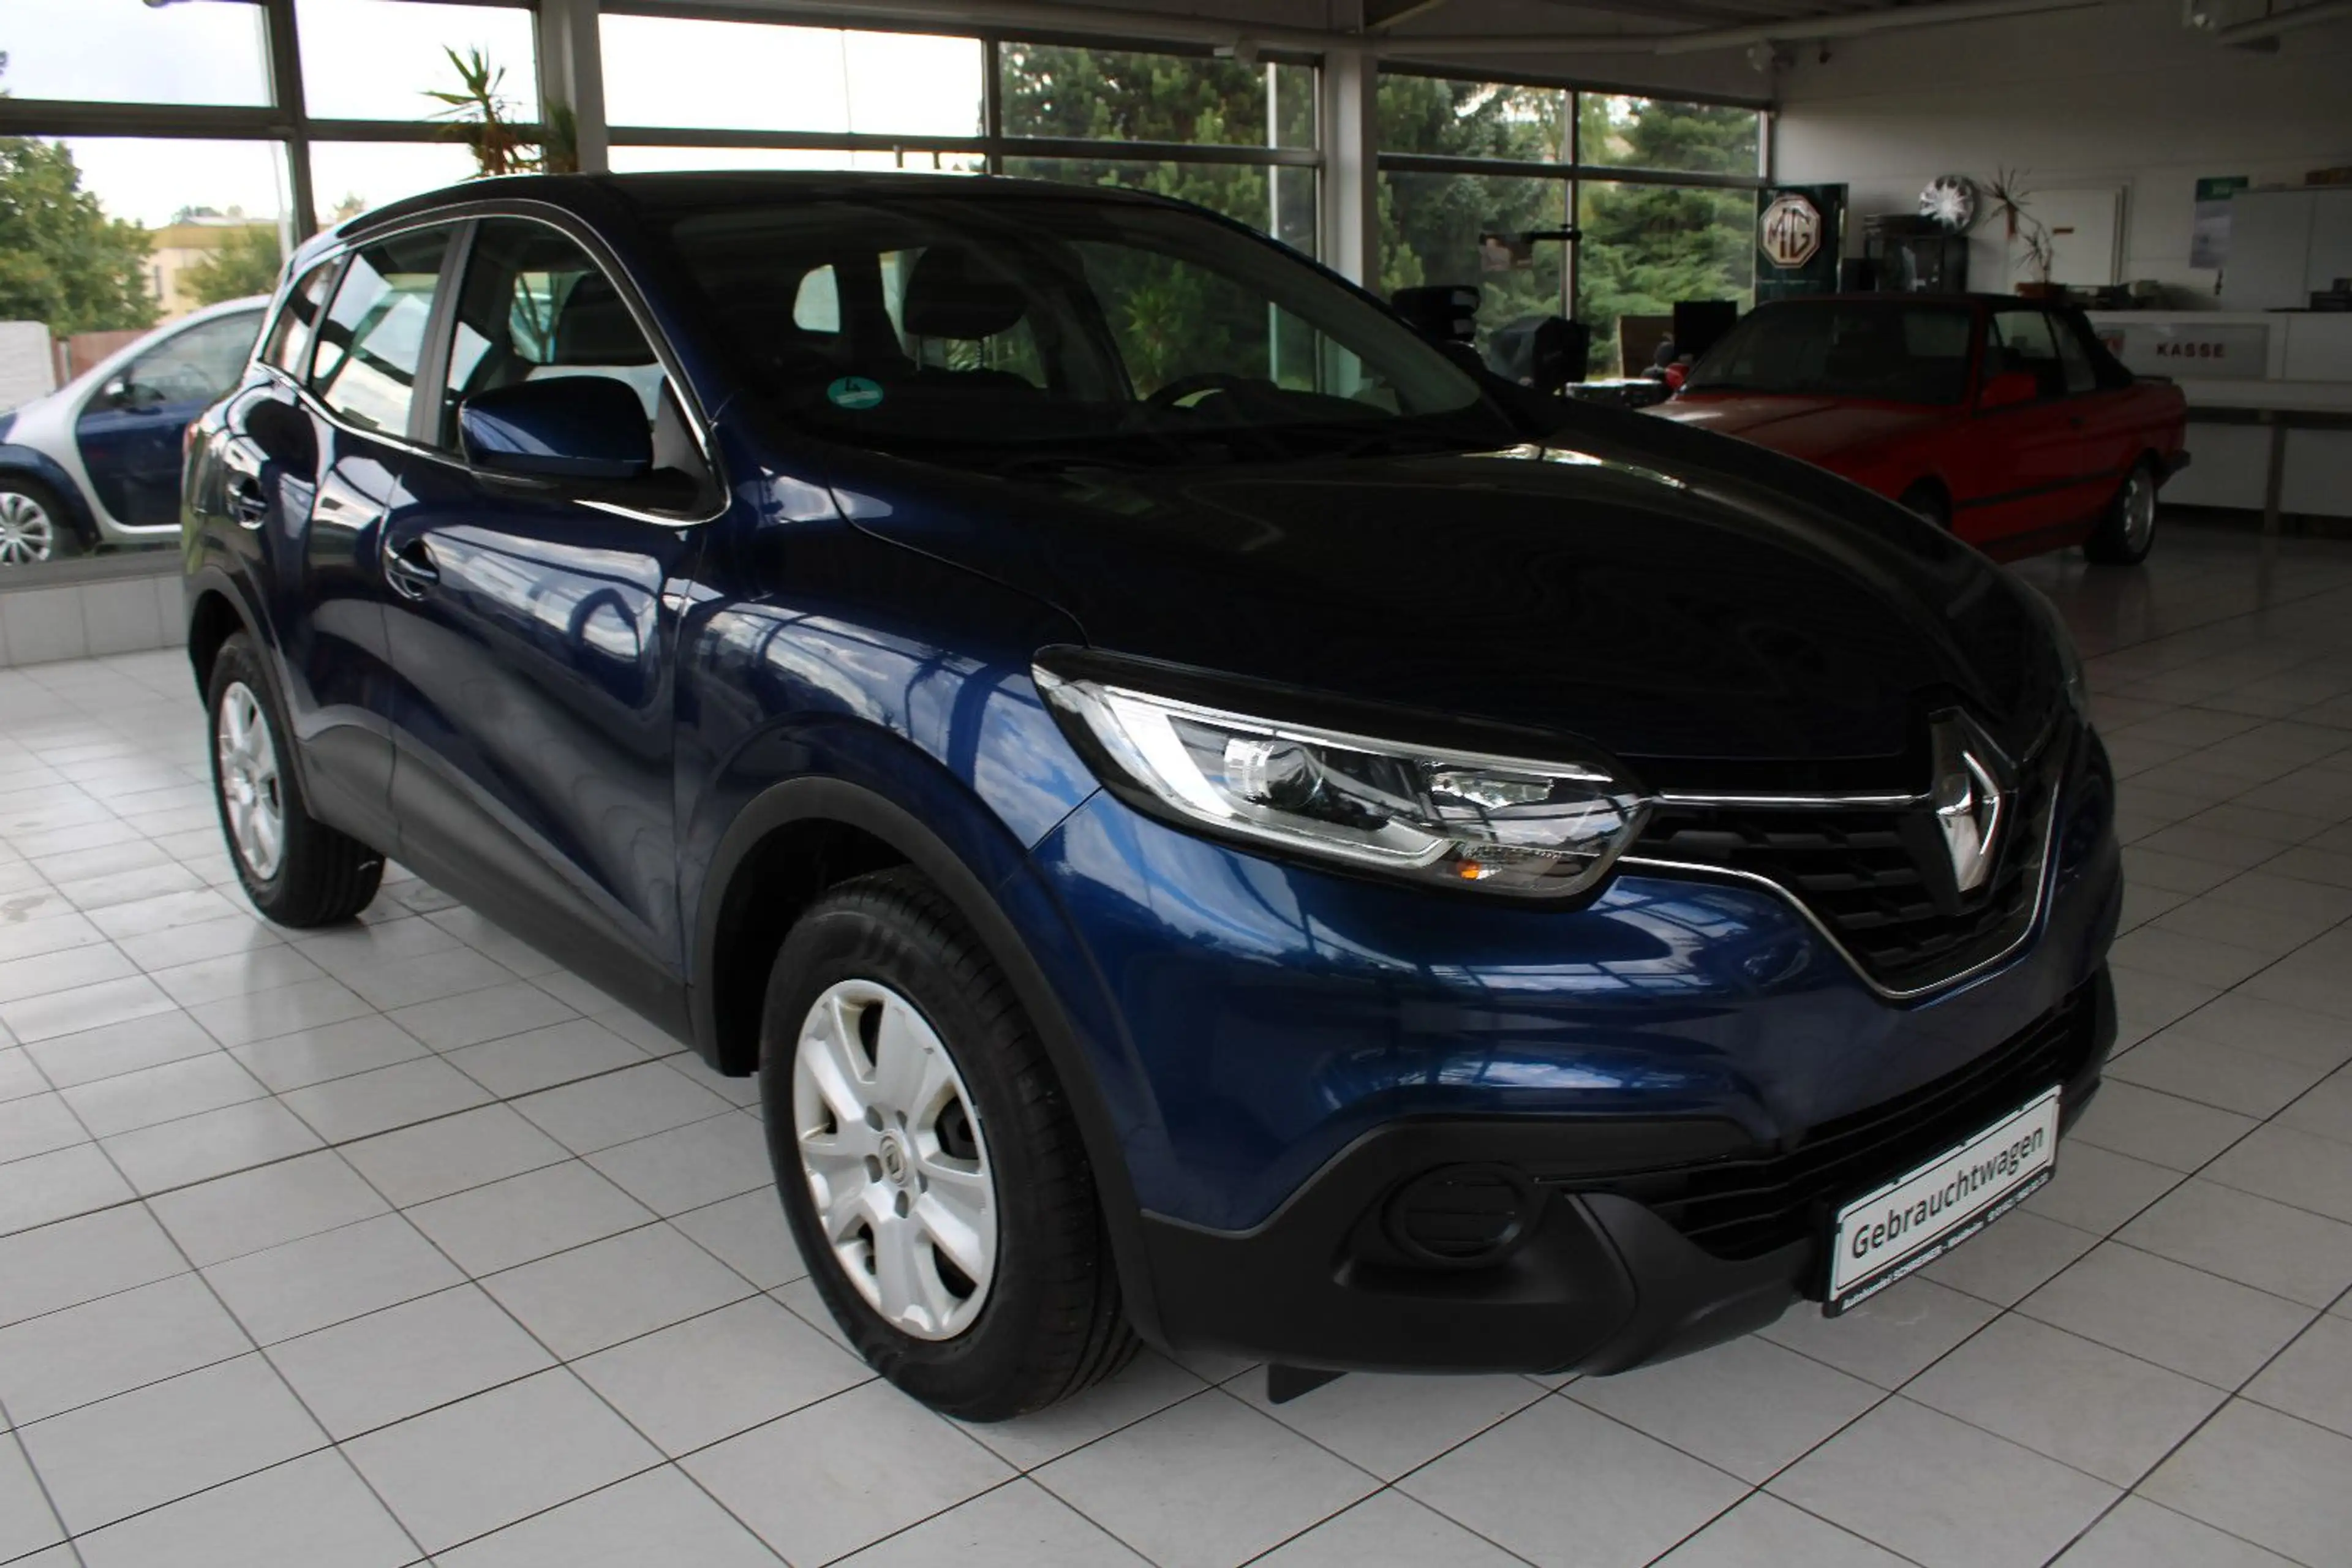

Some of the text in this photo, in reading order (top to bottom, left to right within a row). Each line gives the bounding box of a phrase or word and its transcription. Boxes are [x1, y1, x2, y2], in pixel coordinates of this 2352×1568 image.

[1768, 207, 1811, 259] MG
[2156, 342, 2226, 358] KASSE
[1851, 1127, 2044, 1259] Gebrauchtwagen
